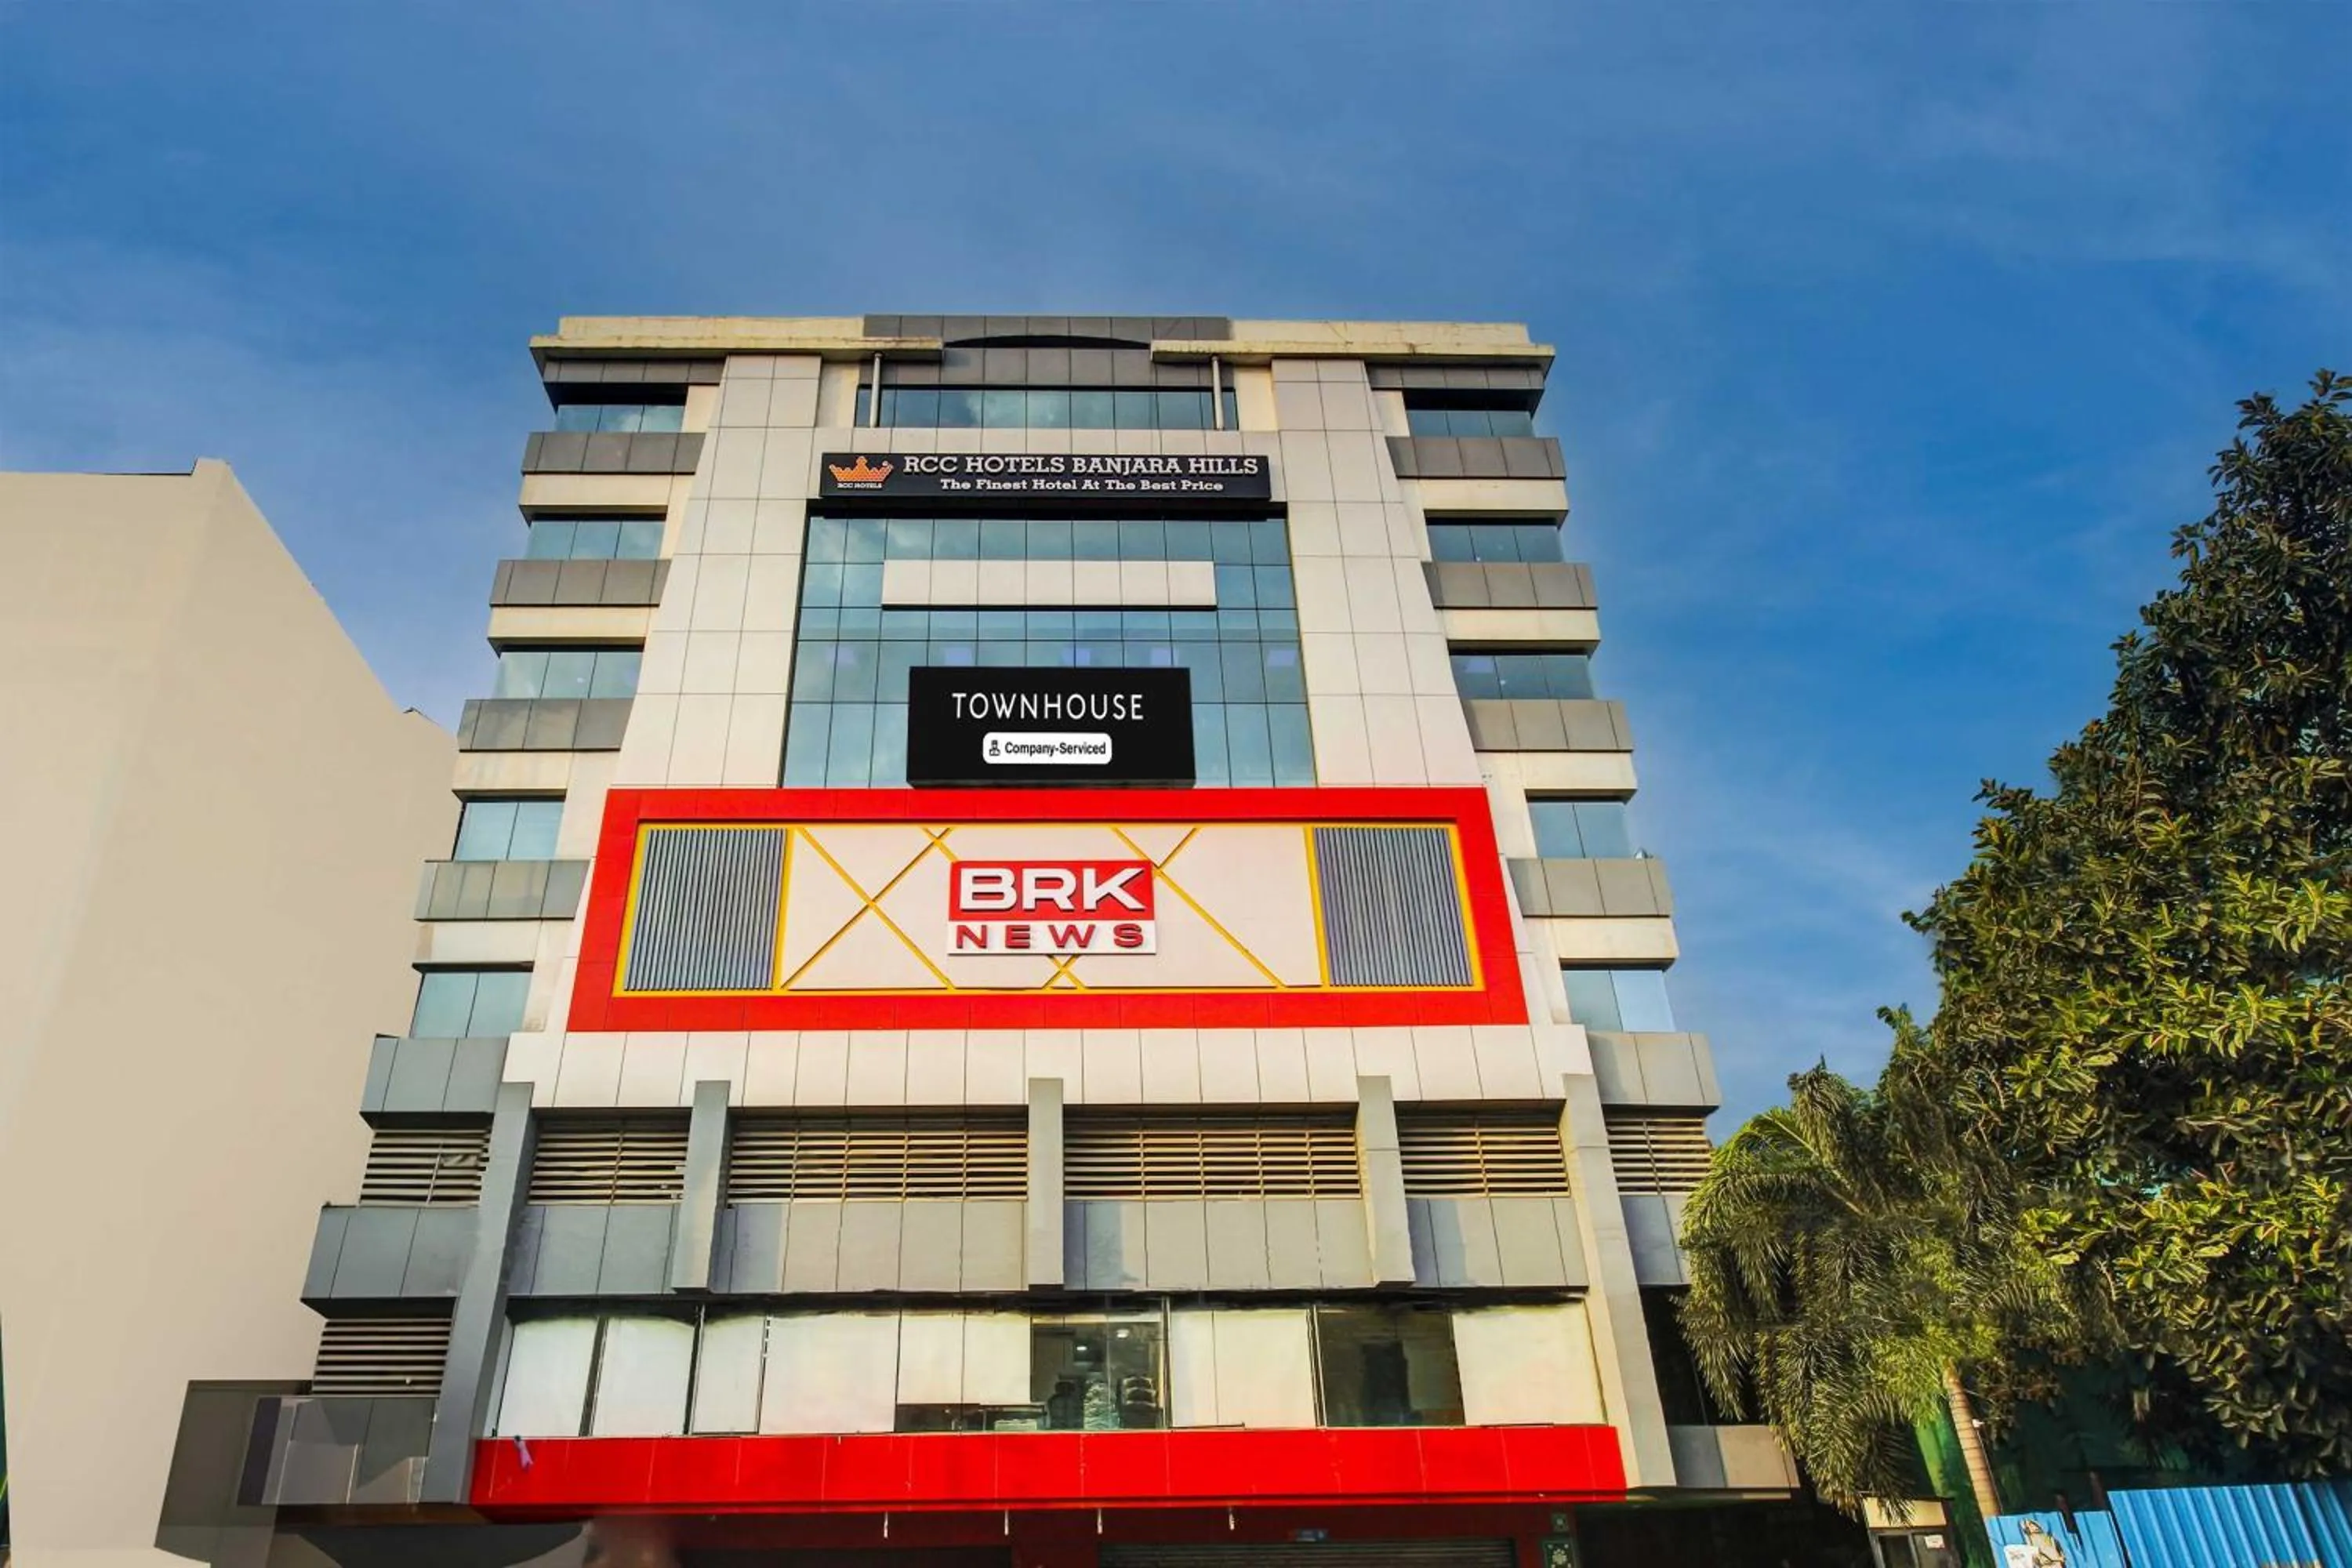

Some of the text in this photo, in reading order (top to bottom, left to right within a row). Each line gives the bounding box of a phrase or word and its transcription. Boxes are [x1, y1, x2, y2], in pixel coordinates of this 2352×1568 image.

[903, 456, 1258, 475] RCC HOTELS BANJARA HILLS
[941, 478, 1224, 491] The Finest Hotel At The Best Price
[952, 692, 1145, 720] TOWNHOUSE
[1004, 742, 1106, 757] Company-Serviced
[959, 867, 1146, 911] BRK
[956, 924, 1144, 949] NEWS
